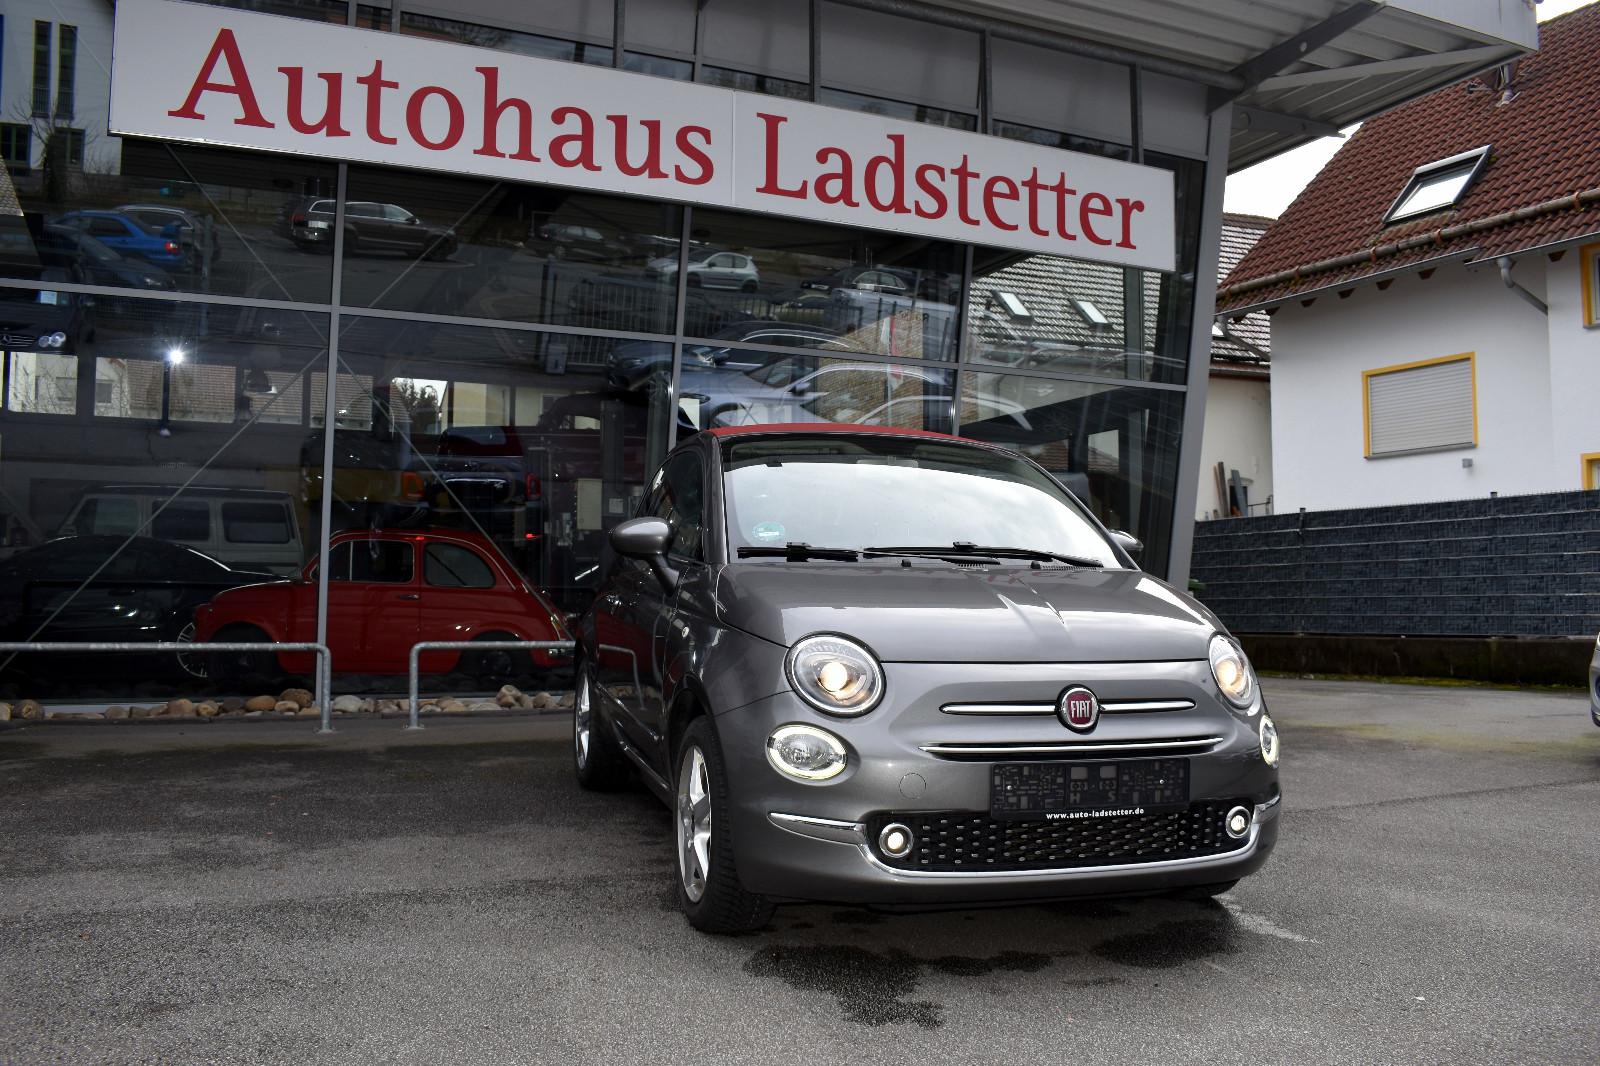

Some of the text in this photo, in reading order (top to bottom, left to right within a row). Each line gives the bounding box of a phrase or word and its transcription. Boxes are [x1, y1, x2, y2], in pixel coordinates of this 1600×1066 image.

[168, 28, 1145, 250] Autohaus Ladstetter
[1070, 700, 1091, 718] FIAT
[1046, 807, 1145, 820] www.auto-ladstetter.de
